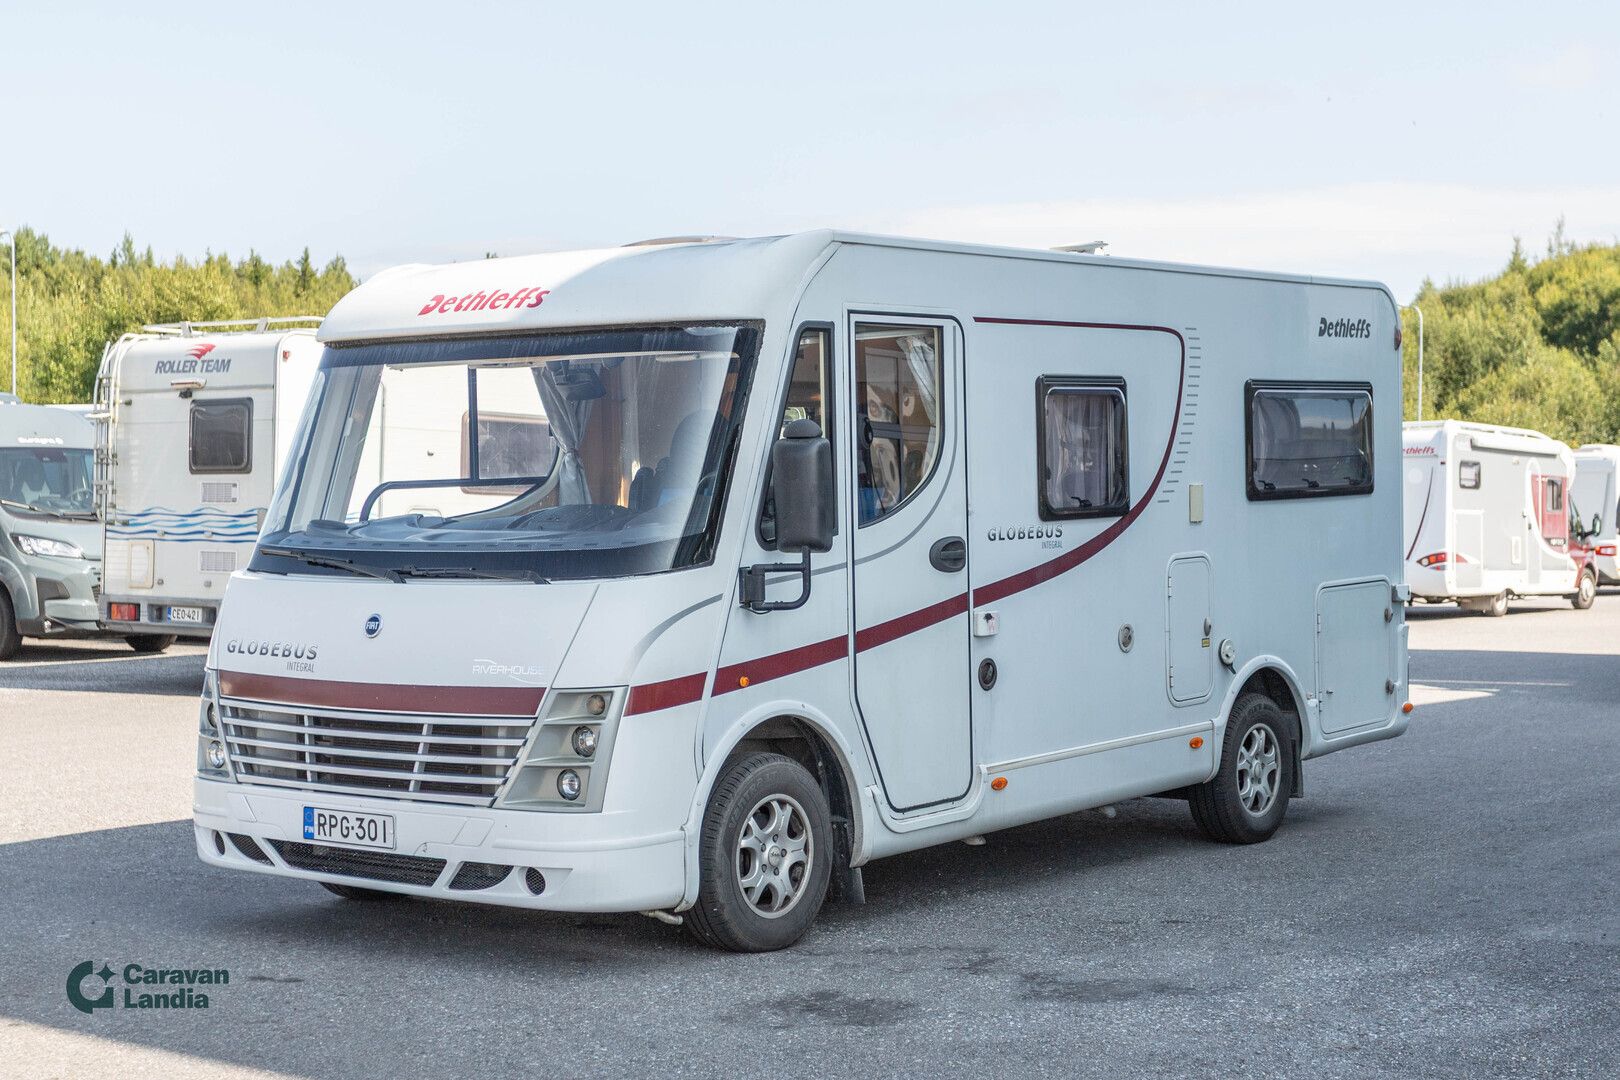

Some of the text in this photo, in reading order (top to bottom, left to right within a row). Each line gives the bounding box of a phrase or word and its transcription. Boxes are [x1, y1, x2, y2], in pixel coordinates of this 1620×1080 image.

[417, 286, 550, 316] Dethleffs
[1318, 317, 1371, 338] Dethleffs
[155, 359, 231, 374] ROLLER TEAM
[988, 524, 1063, 541] GLOBEBUS
[227, 639, 318, 660] GLOBEBUS
[286, 661, 315, 673] INTEGRAL
[317, 812, 387, 844] RPG-301
